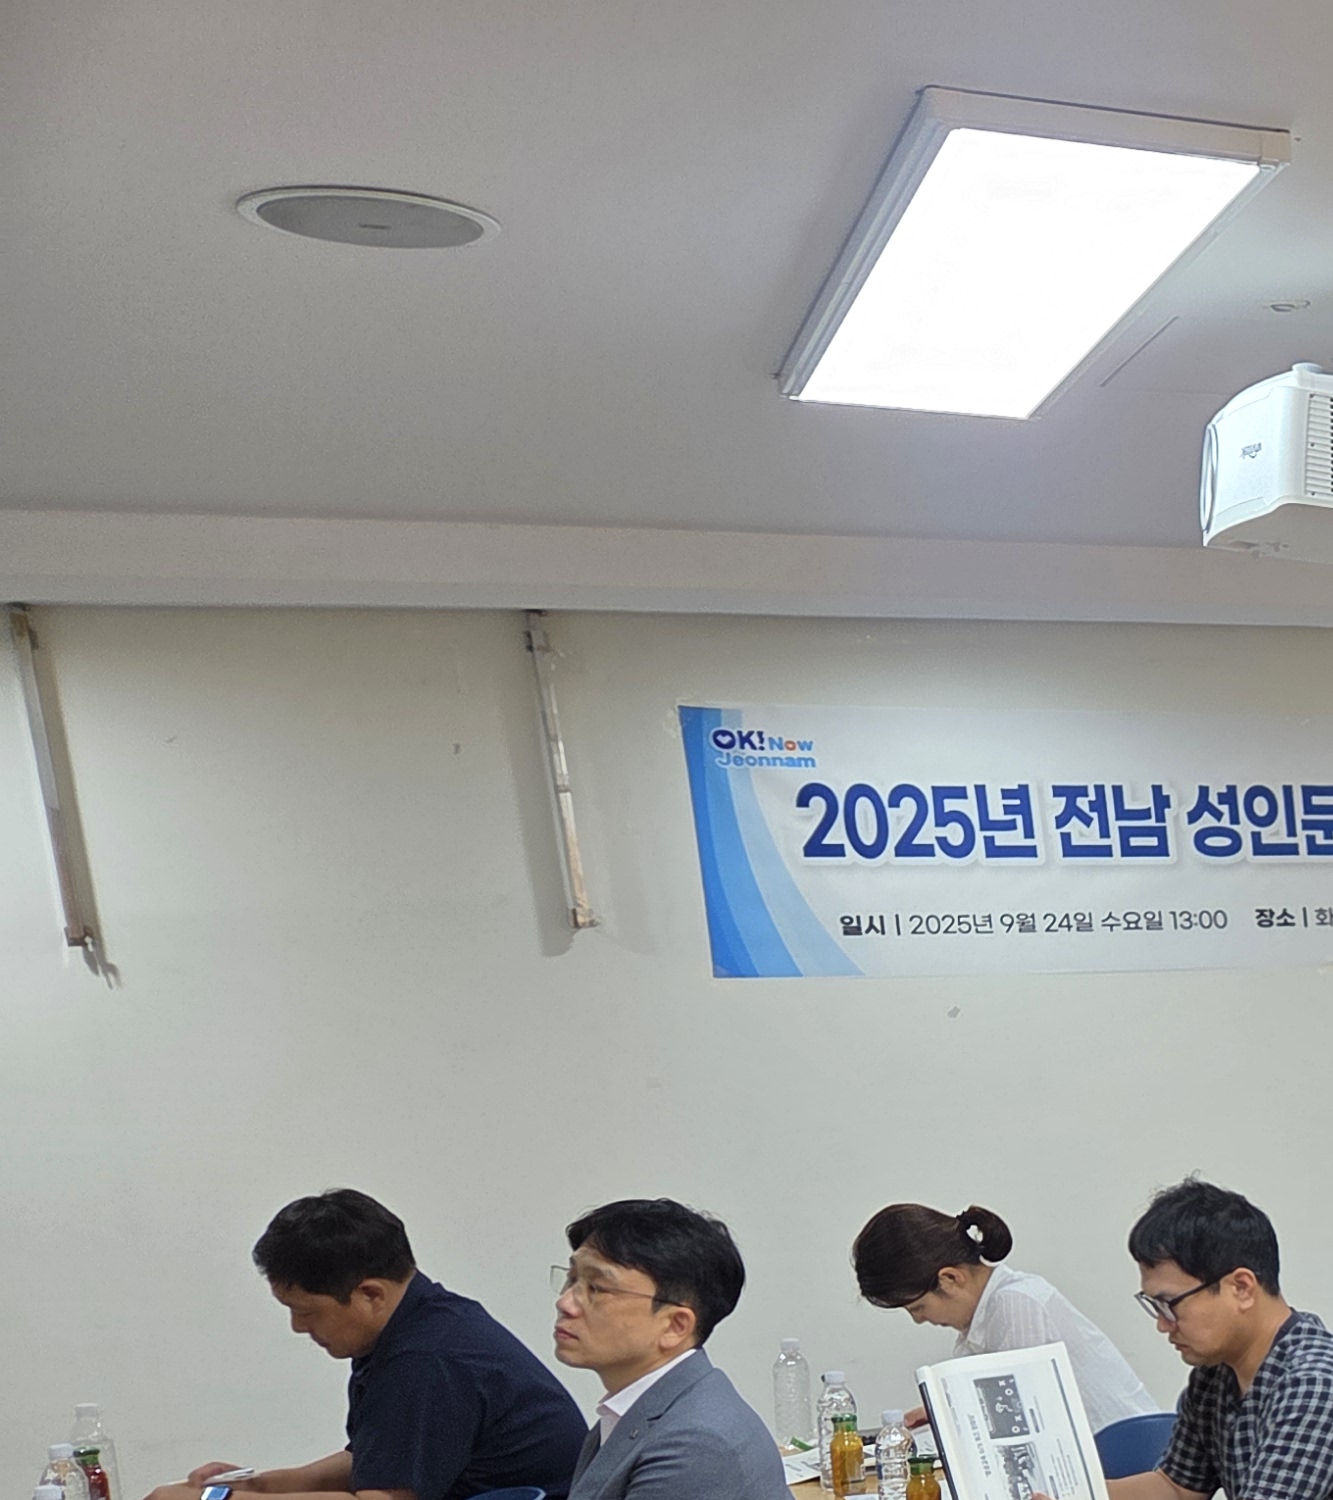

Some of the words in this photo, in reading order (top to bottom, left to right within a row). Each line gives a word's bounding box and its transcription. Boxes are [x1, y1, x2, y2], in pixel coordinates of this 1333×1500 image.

[712, 729, 765, 751] OK!
[768, 736, 814, 752] Now
[715, 752, 816, 768] Jeonnam
[796, 783, 1038, 858] 2025년
[1054, 783, 1172, 858] 전남
[839, 914, 886, 937] 일시
[909, 913, 994, 936] 2025년
[999, 912, 1037, 935] 9월
[1043, 911, 1094, 934] 24일
[1101, 910, 1164, 933] 수요일
[1170, 909, 1229, 931] 13:00
[1255, 907, 1296, 930] 장소
